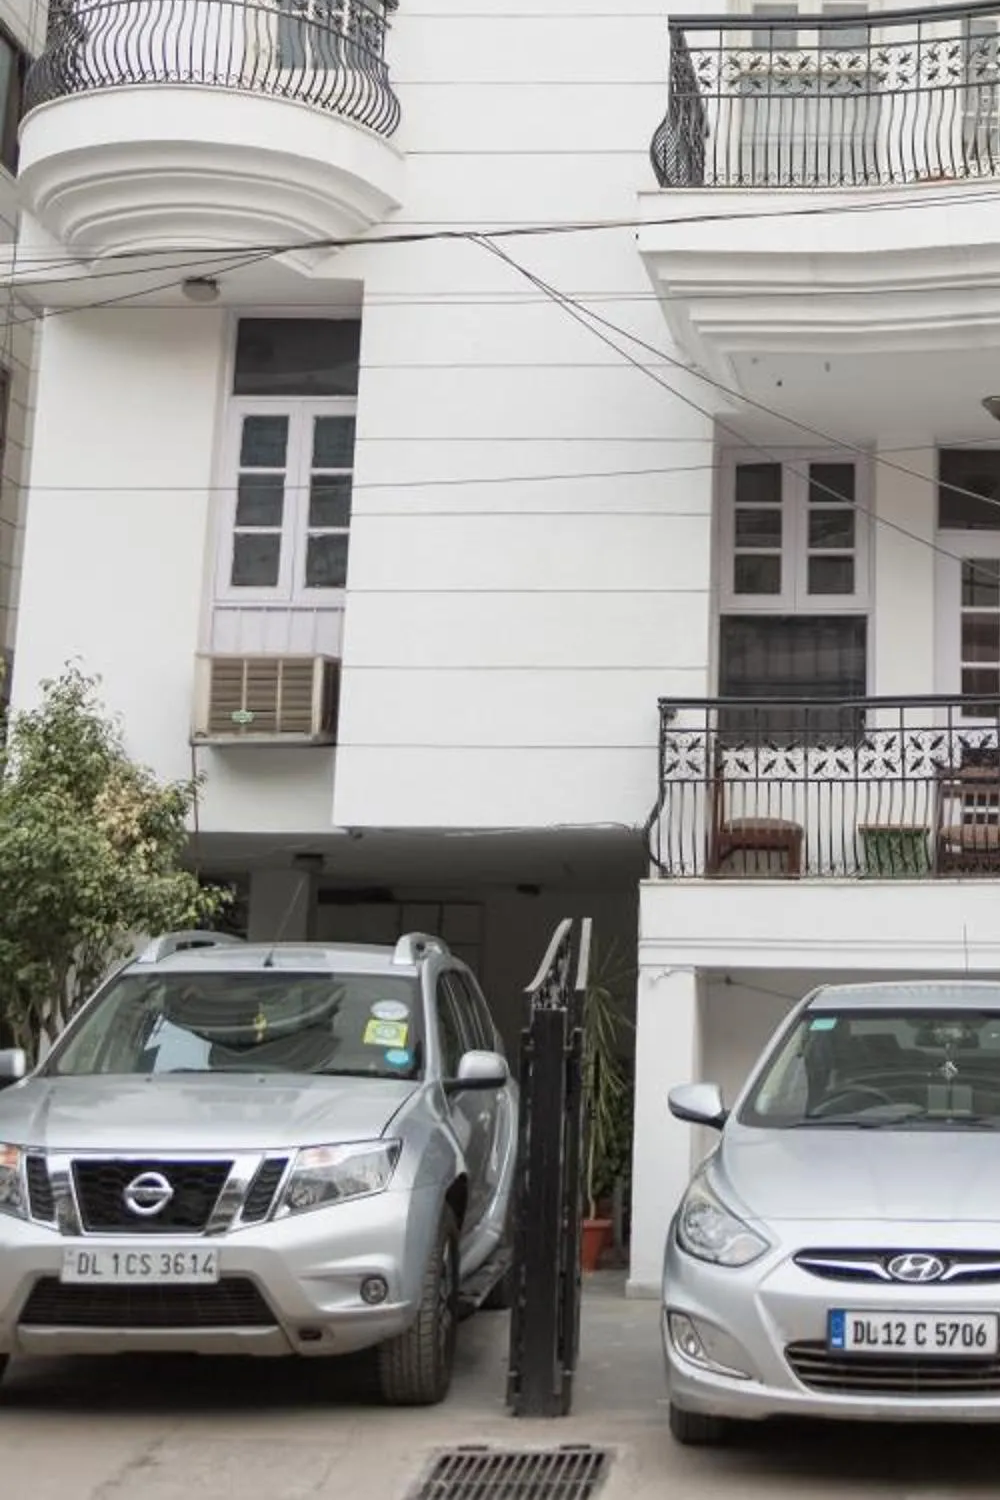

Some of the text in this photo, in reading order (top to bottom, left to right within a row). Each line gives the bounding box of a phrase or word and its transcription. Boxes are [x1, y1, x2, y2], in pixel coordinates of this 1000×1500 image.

[77, 1252, 102, 1275] DL
[112, 1252, 151, 1275] 1CS
[160, 1252, 213, 1276] 3614
[935, 1322, 987, 1347] 5706
